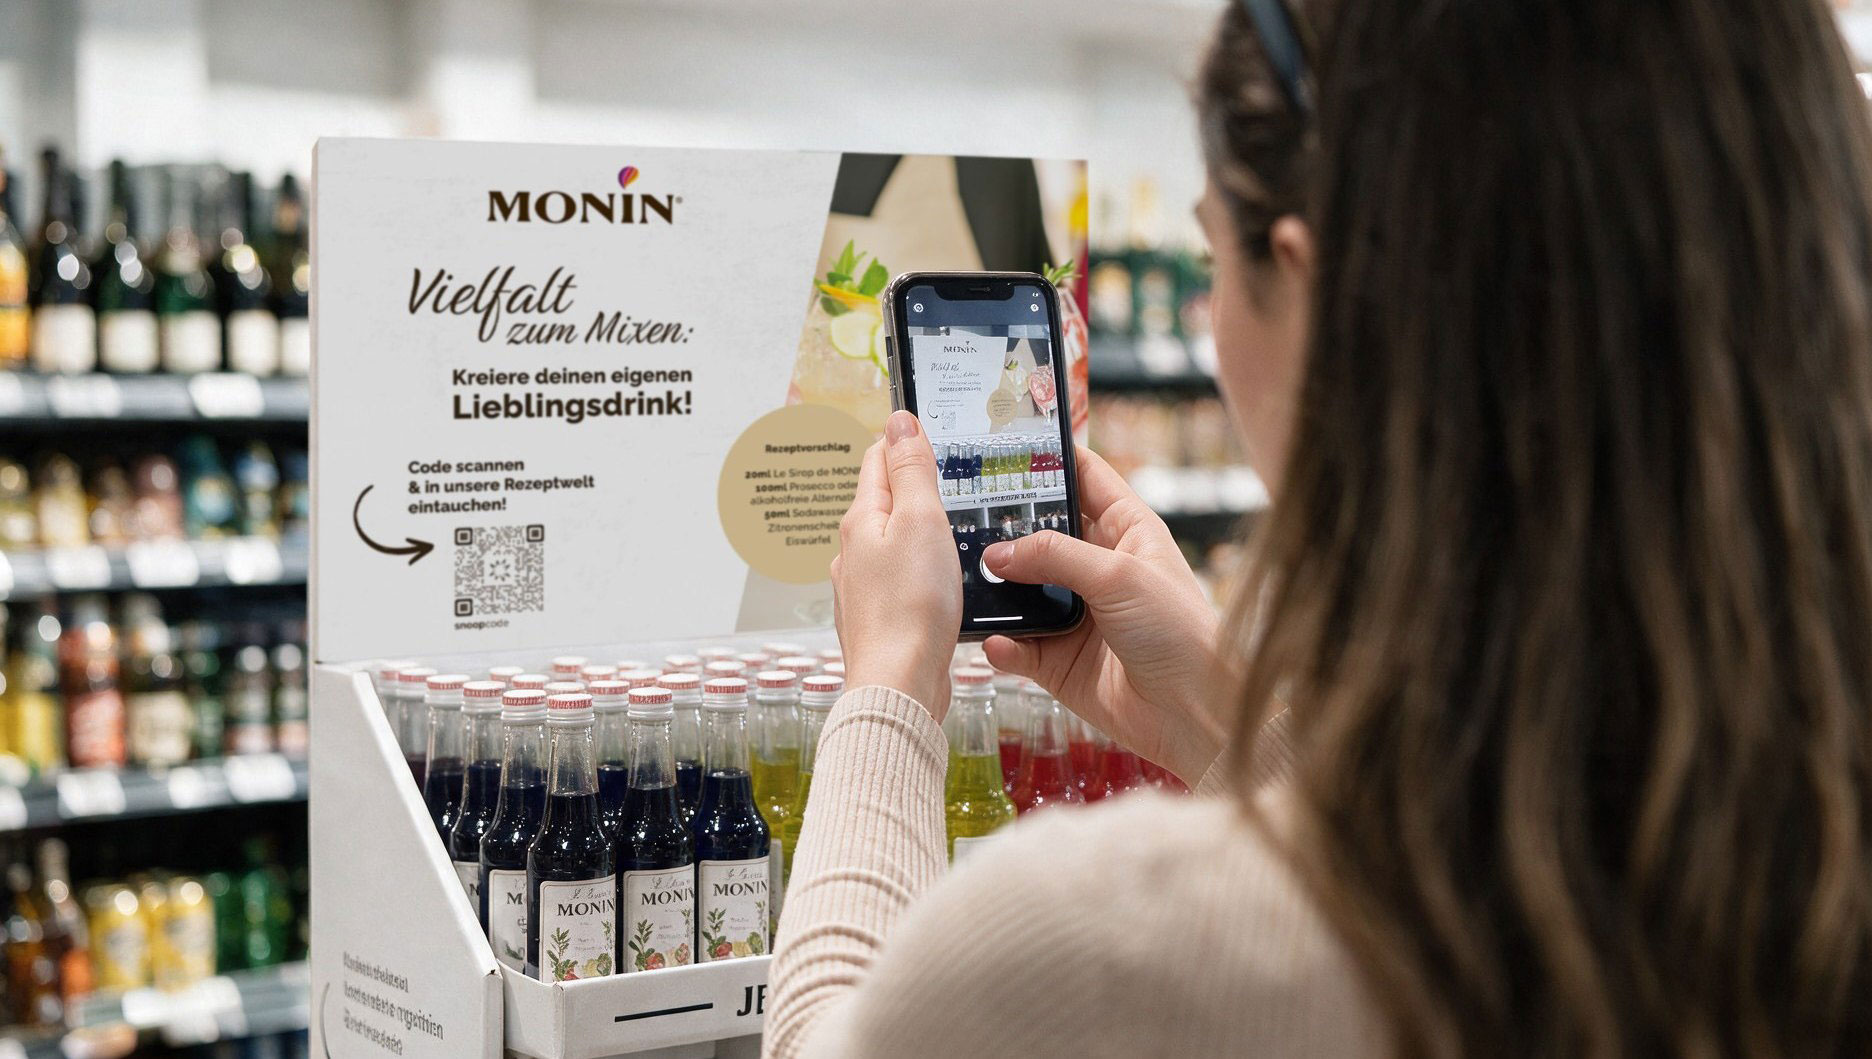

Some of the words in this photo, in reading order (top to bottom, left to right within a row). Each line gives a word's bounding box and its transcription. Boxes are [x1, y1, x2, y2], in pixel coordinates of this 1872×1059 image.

[408, 265, 577, 343] Vielfalt
[505, 322, 579, 346] zum
[583, 310, 694, 345] Mixen:
[452, 368, 530, 386] Kreiere
[534, 367, 606, 385] deinen
[610, 366, 693, 387] eigenen
[453, 390, 692, 424] Lieblingsdrink!
[765, 442, 851, 454] Rezeptvorschlag
[408, 460, 452, 474] Code
[456, 460, 525, 473] scannen
[745, 469, 772, 479] 20ml
[773, 469, 786, 478] Le
[789, 467, 814, 479] Sirop
[816, 467, 829, 476] de
[408, 481, 420, 494] &
[425, 480, 440, 493] in
[444, 479, 500, 492] unsere
[504, 475, 594, 493] Rezeptwelt
[756, 482, 788, 493] 100ml
[789, 482, 835, 491] Prosecco
[408, 498, 507, 514] eintauchen!
[750, 494, 809, 505] alkoholfreie
[764, 509, 791, 520] 50ml
[785, 535, 831, 546] Eiswürfel
[454, 619, 510, 630] snoopcode
